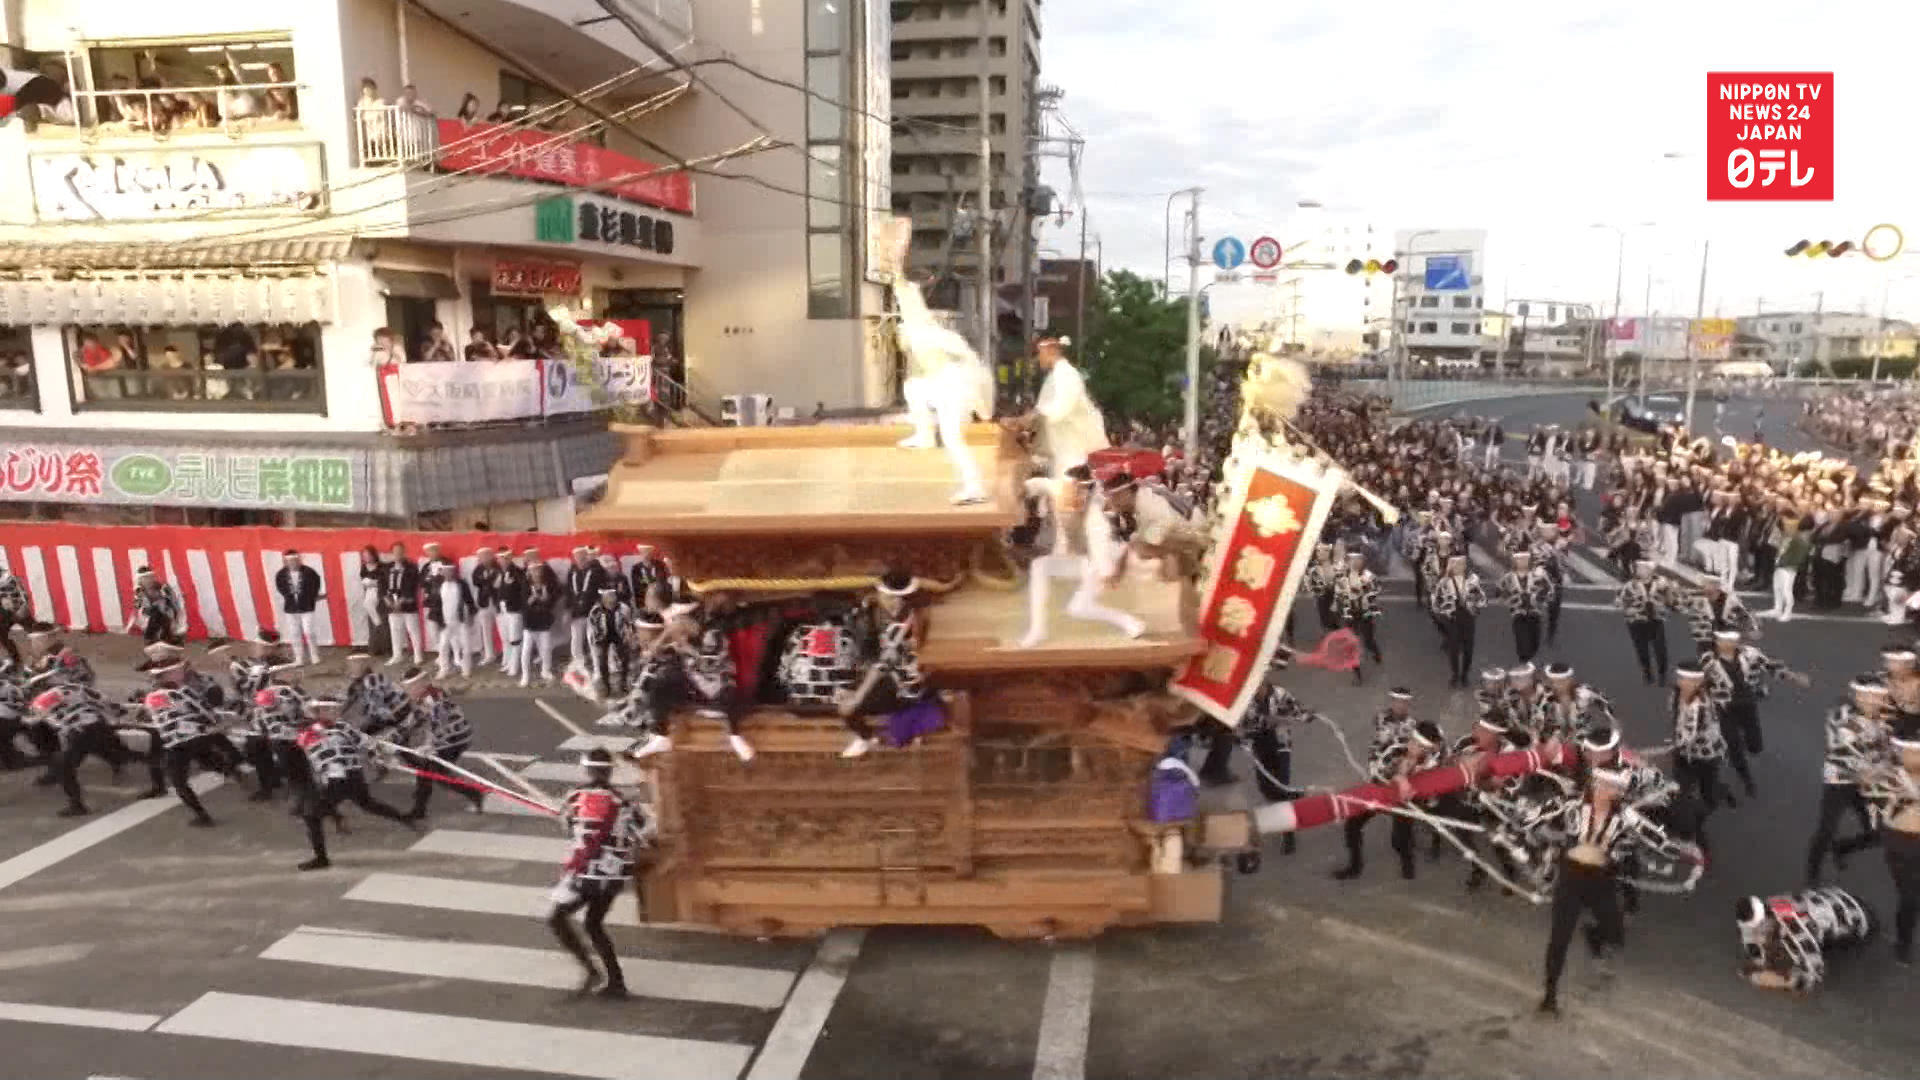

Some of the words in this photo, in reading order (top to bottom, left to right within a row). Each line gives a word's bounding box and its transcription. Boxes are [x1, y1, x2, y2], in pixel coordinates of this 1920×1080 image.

[175, 453, 353, 504] テレビ岸和田
